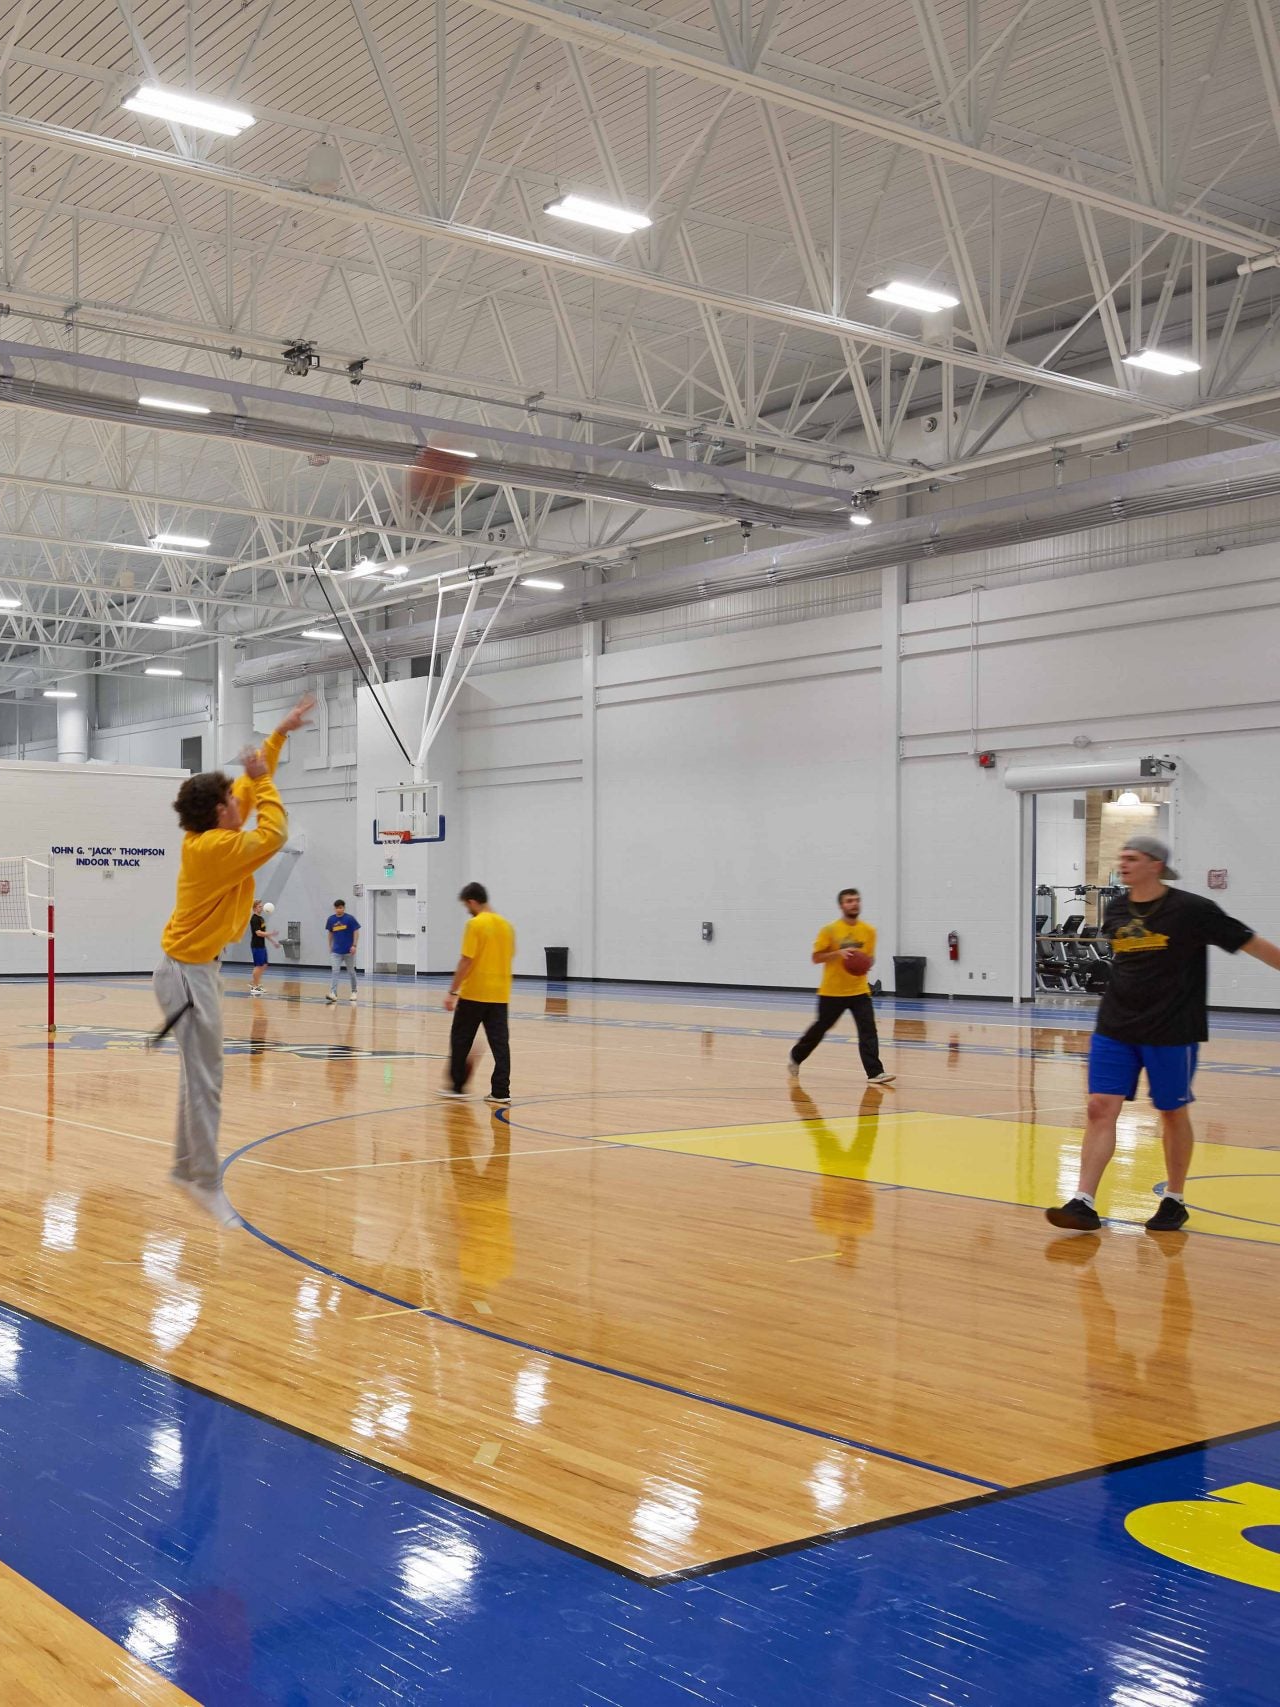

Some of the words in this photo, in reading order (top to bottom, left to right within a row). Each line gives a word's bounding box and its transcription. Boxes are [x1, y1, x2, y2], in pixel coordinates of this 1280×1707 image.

[52, 846, 73, 855] JOHN
[77, 847, 85, 855] G.
[88, 847, 116, 857] "JACK"
[120, 848, 165, 856] THOMPSON
[76, 858, 109, 866] INDOOR
[113, 859, 140, 867] TRACK
